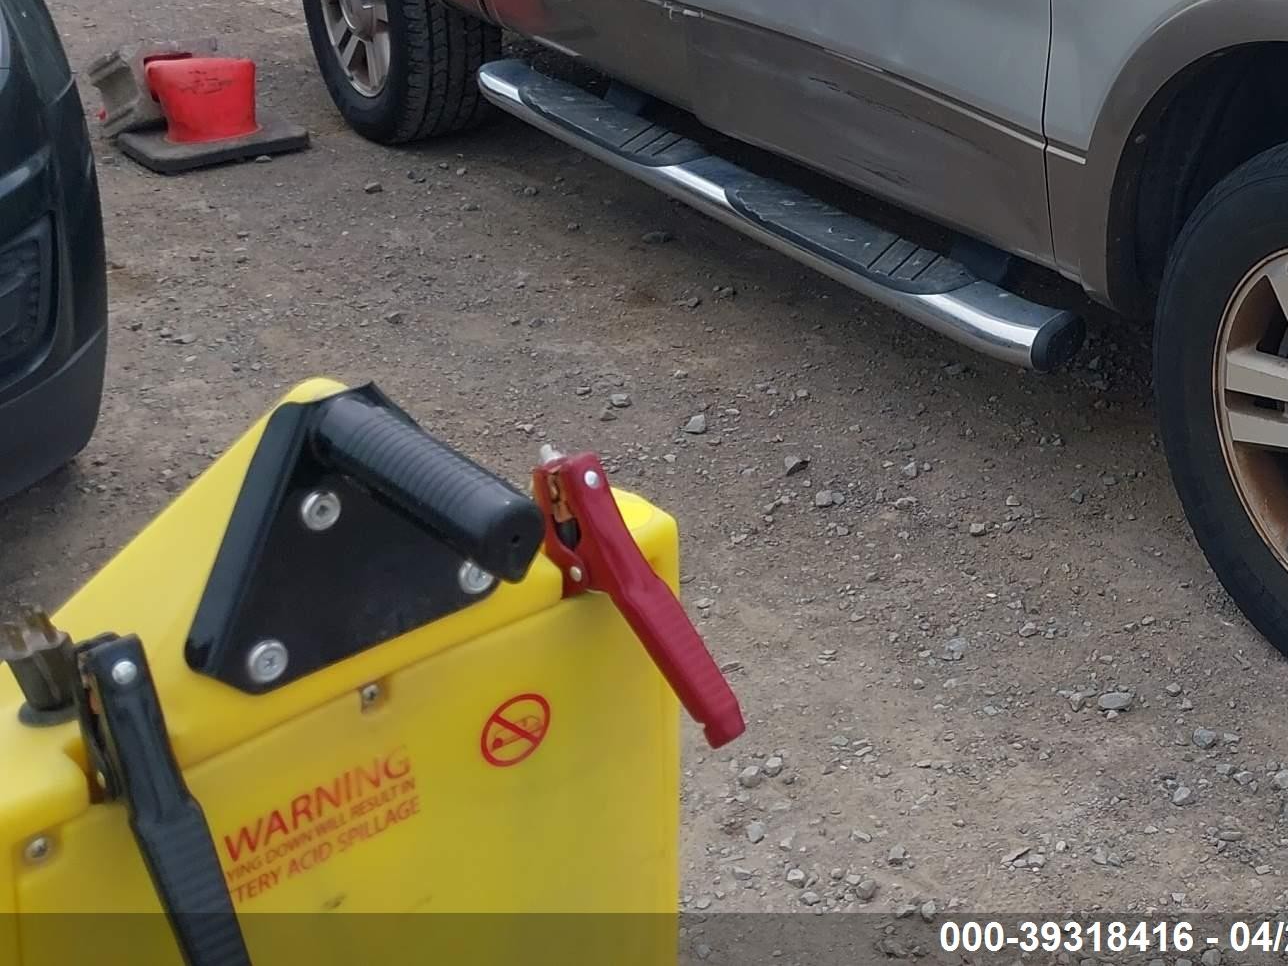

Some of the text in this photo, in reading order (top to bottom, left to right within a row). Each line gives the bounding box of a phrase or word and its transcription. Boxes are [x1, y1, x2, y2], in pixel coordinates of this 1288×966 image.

[224, 745, 411, 862] WARNING
[265, 829, 312, 864] DOWN
[350, 785, 399, 818] RESULT
[288, 841, 333, 878] ACID
[337, 795, 421, 853] SPILLAGE
